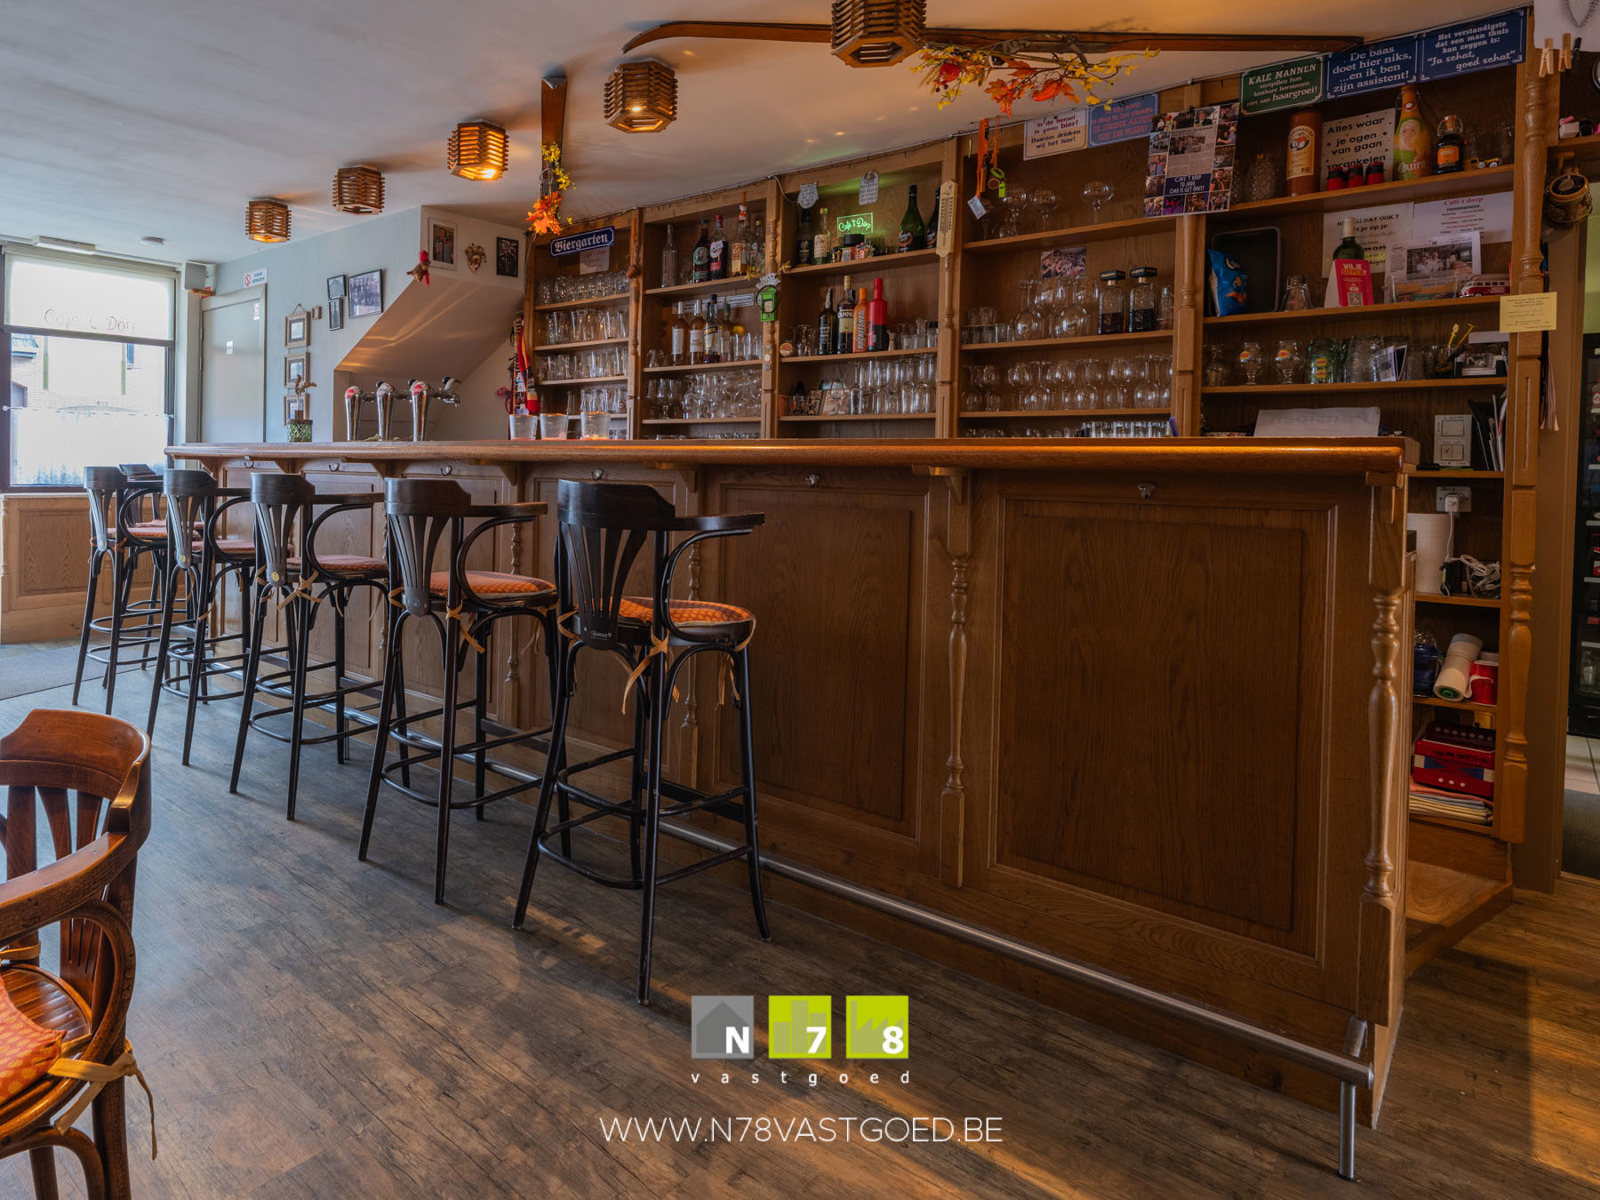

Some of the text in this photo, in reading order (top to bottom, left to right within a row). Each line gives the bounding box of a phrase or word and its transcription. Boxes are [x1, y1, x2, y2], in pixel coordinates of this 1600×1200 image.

[1435, 40, 1449, 48] dat
[1467, 33, 1485, 42] man
[1488, 27, 1509, 37] thuis
[1438, 21, 1507, 41] Het verstandigste
[1350, 45, 1395, 62] De baas
[1442, 36, 1501, 54] kan zeggen is:
[1446, 50, 1475, 62] schat,
[1456, 56, 1480, 72] goed
[1248, 63, 1317, 86] KALE MANNEN
[1333, 64, 1356, 75] doet
[1360, 57, 1381, 69] hier
[1366, 66, 1377, 77] ik
[1380, 62, 1401, 74] ben
[1333, 70, 1409, 94] zijn assistent!
[1273, 86, 1318, 101] haargroei!
[1061, 119, 1079, 129] bier!
[1327, 121, 1353, 135] Alles
[1356, 117, 1385, 129] waar
[1331, 140, 1382, 156] van gaan
[1335, 132, 1377, 148] je ogen
[554, 233, 609, 252] Biergarten
